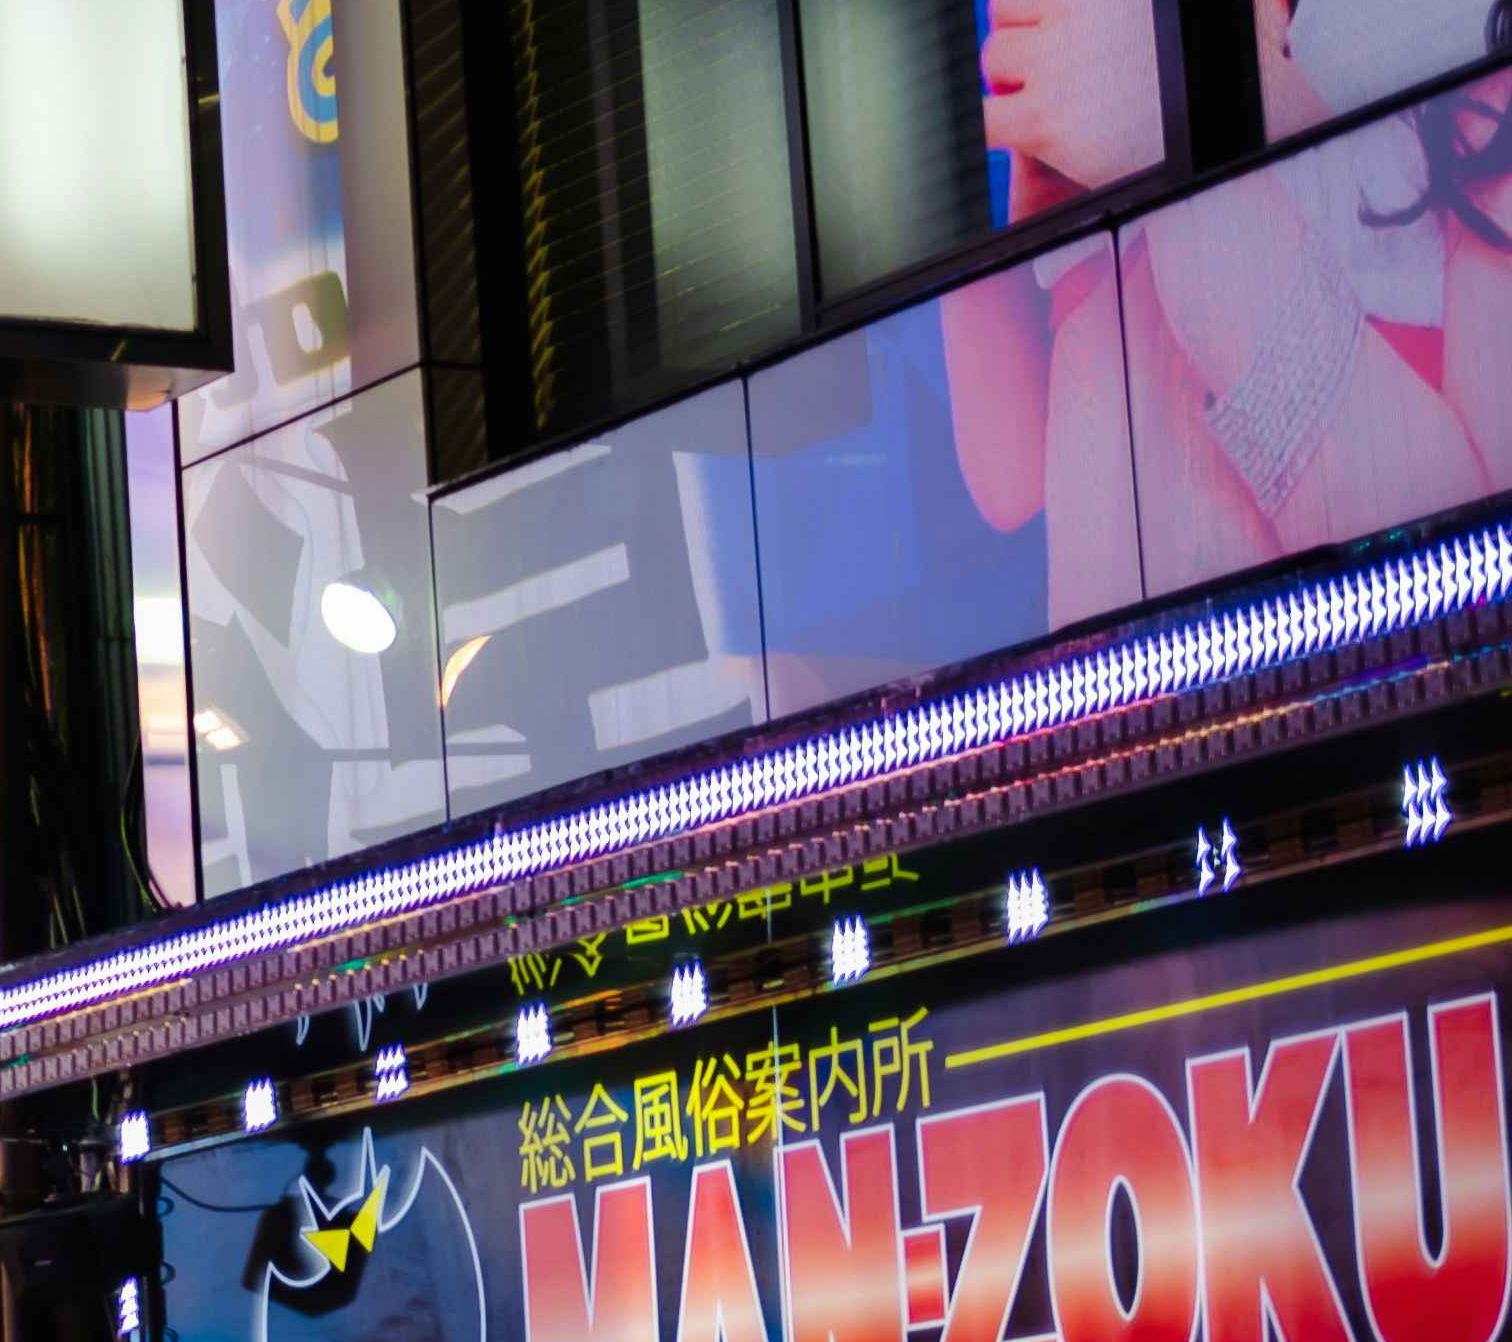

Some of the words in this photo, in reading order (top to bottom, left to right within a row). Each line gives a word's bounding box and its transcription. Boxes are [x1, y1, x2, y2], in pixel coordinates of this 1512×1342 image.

[518, 1009, 933, 1192] 総合風俗案内所
